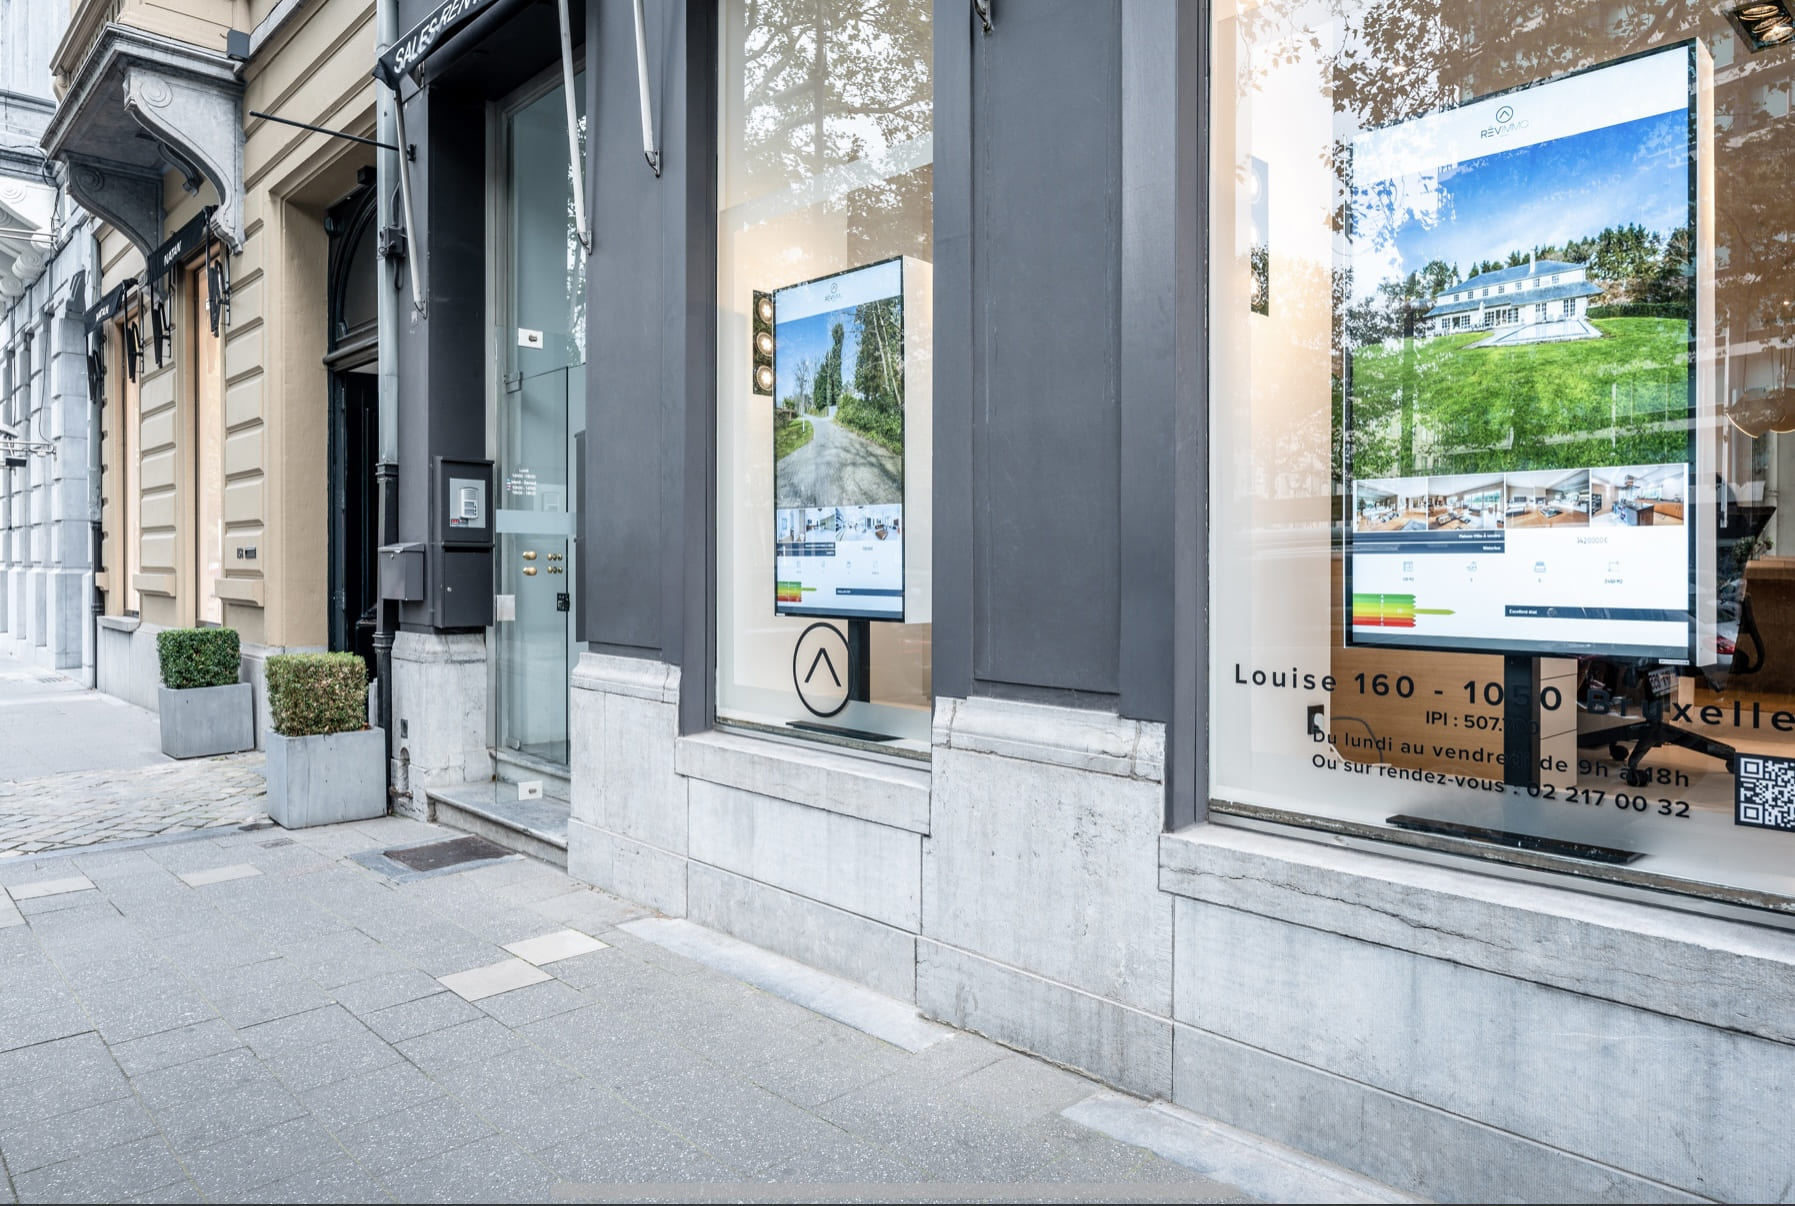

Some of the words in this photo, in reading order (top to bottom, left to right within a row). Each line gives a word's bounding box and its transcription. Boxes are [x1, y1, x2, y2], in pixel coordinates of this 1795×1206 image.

[394, 17, 440, 73] SALES
[164, 240, 182, 267] NATAN
[1235, 663, 1337, 692] Louise
[1355, 672, 1415, 698] 160
[1463, 680, 1562, 711] 1050
[1425, 711, 1448, 726] IPI
[1313, 729, 1337, 745] Du
[1345, 732, 1392, 751] lundi
[1400, 742, 1424, 755] au
[1539, 755, 1568, 772] de
[1578, 759, 1608, 778] 9h
[1645, 767, 1689, 787] 18h
[1312, 753, 1337, 770] Ou
[1344, 760, 1372, 775] sur
[1379, 765, 1505, 793] rendez-vous
[1527, 782, 1556, 800] 02
[1565, 786, 1606, 806] 217
[1614, 793, 1648, 812] 00
[1657, 799, 1690, 819] 32
